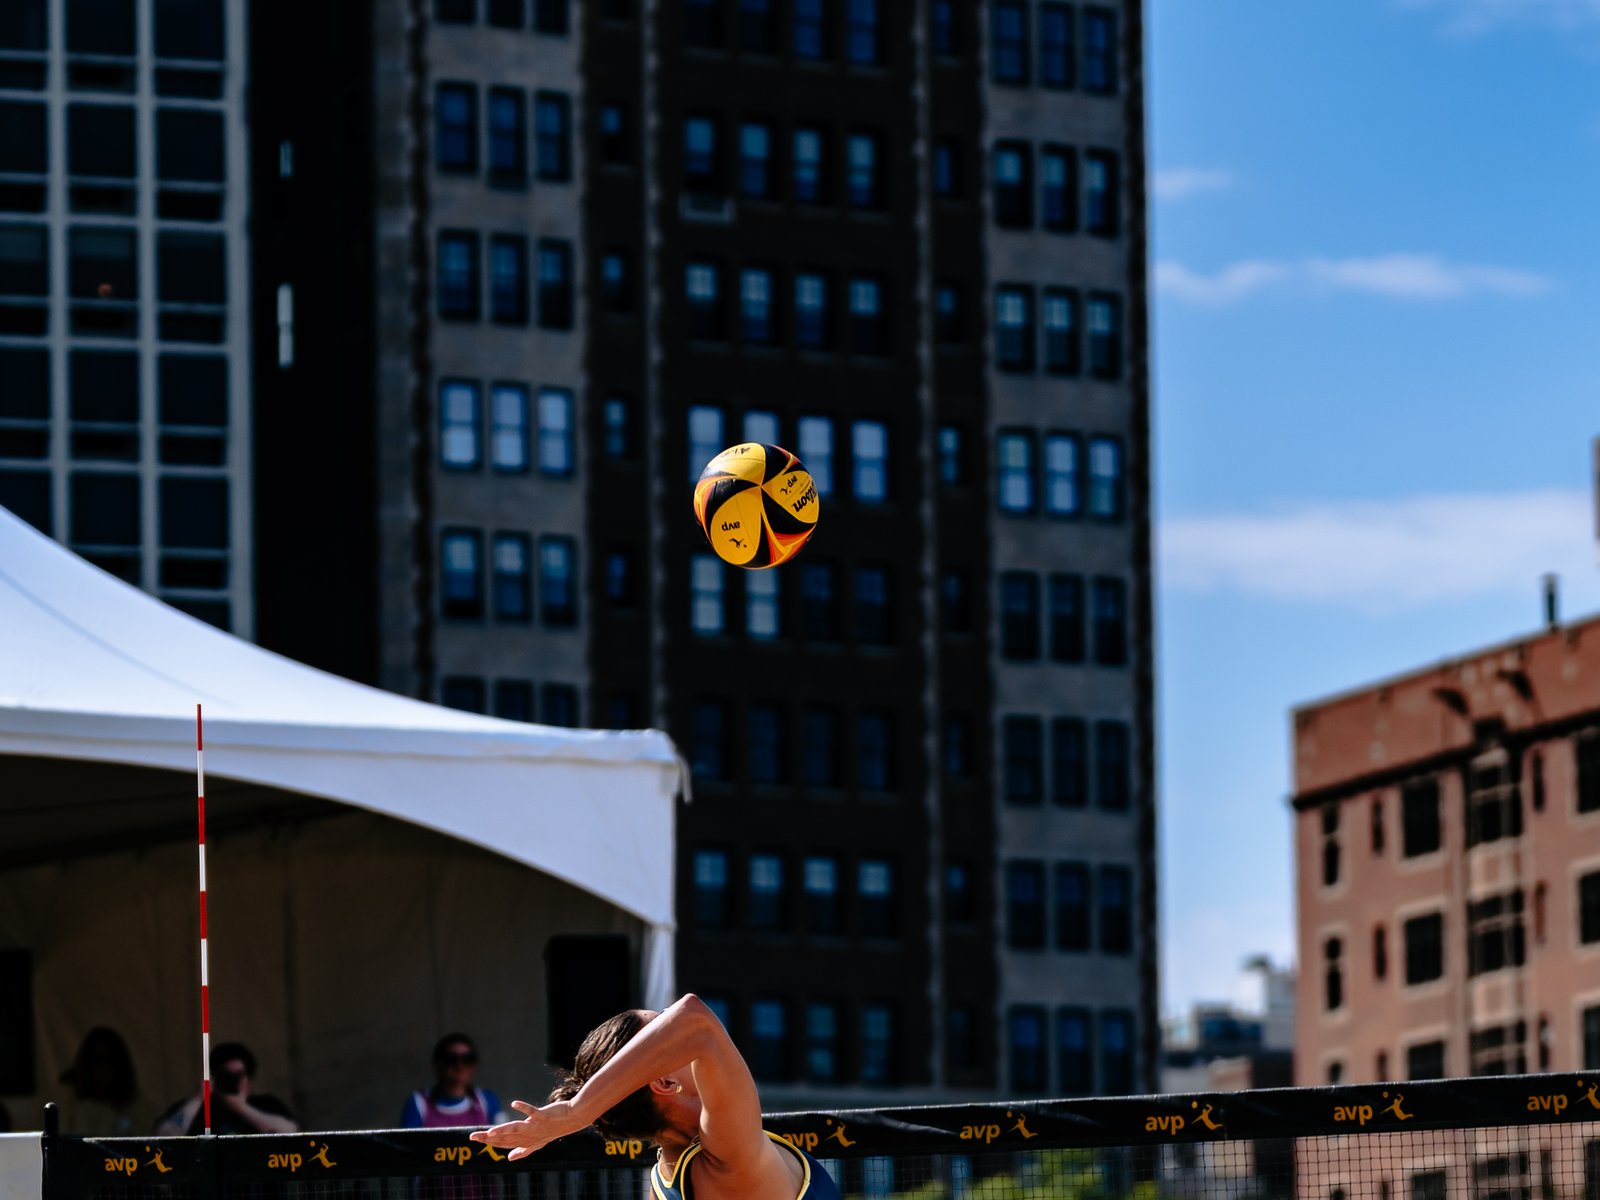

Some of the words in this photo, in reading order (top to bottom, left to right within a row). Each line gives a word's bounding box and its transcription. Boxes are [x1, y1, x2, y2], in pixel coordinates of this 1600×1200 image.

[721, 521, 741, 532] avp
[1527, 1094, 1568, 1115] avp
[1333, 1104, 1373, 1126] avp
[960, 1124, 1000, 1144] avp
[1145, 1115, 1185, 1136] avp
[434, 1146, 471, 1165] avp
[605, 1139, 642, 1159] avp
[104, 1157, 138, 1176] avp
[268, 1153, 302, 1172] avp
